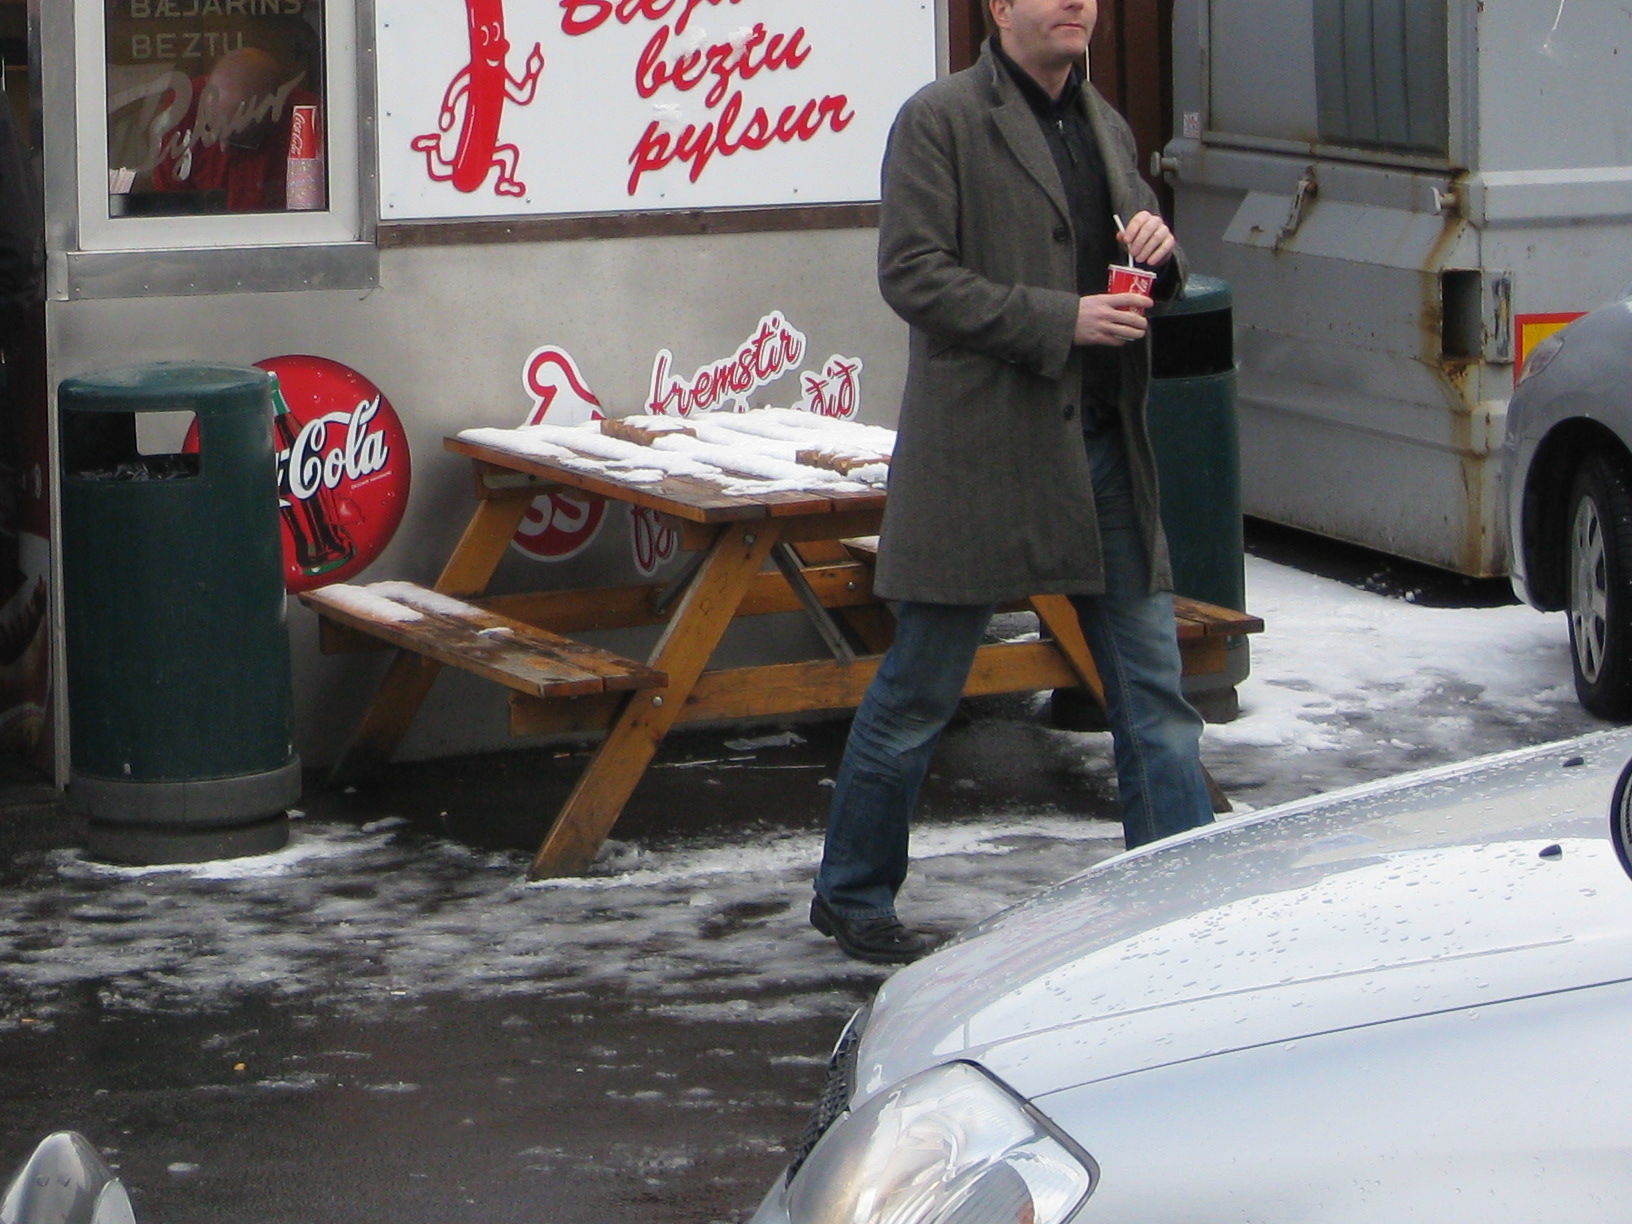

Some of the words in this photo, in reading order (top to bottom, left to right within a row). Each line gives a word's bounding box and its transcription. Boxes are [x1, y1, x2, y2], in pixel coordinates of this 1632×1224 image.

[131, 31, 244, 60] BEZTU
[635, 22, 813, 108] beztu
[628, 90, 855, 196] pylsur
